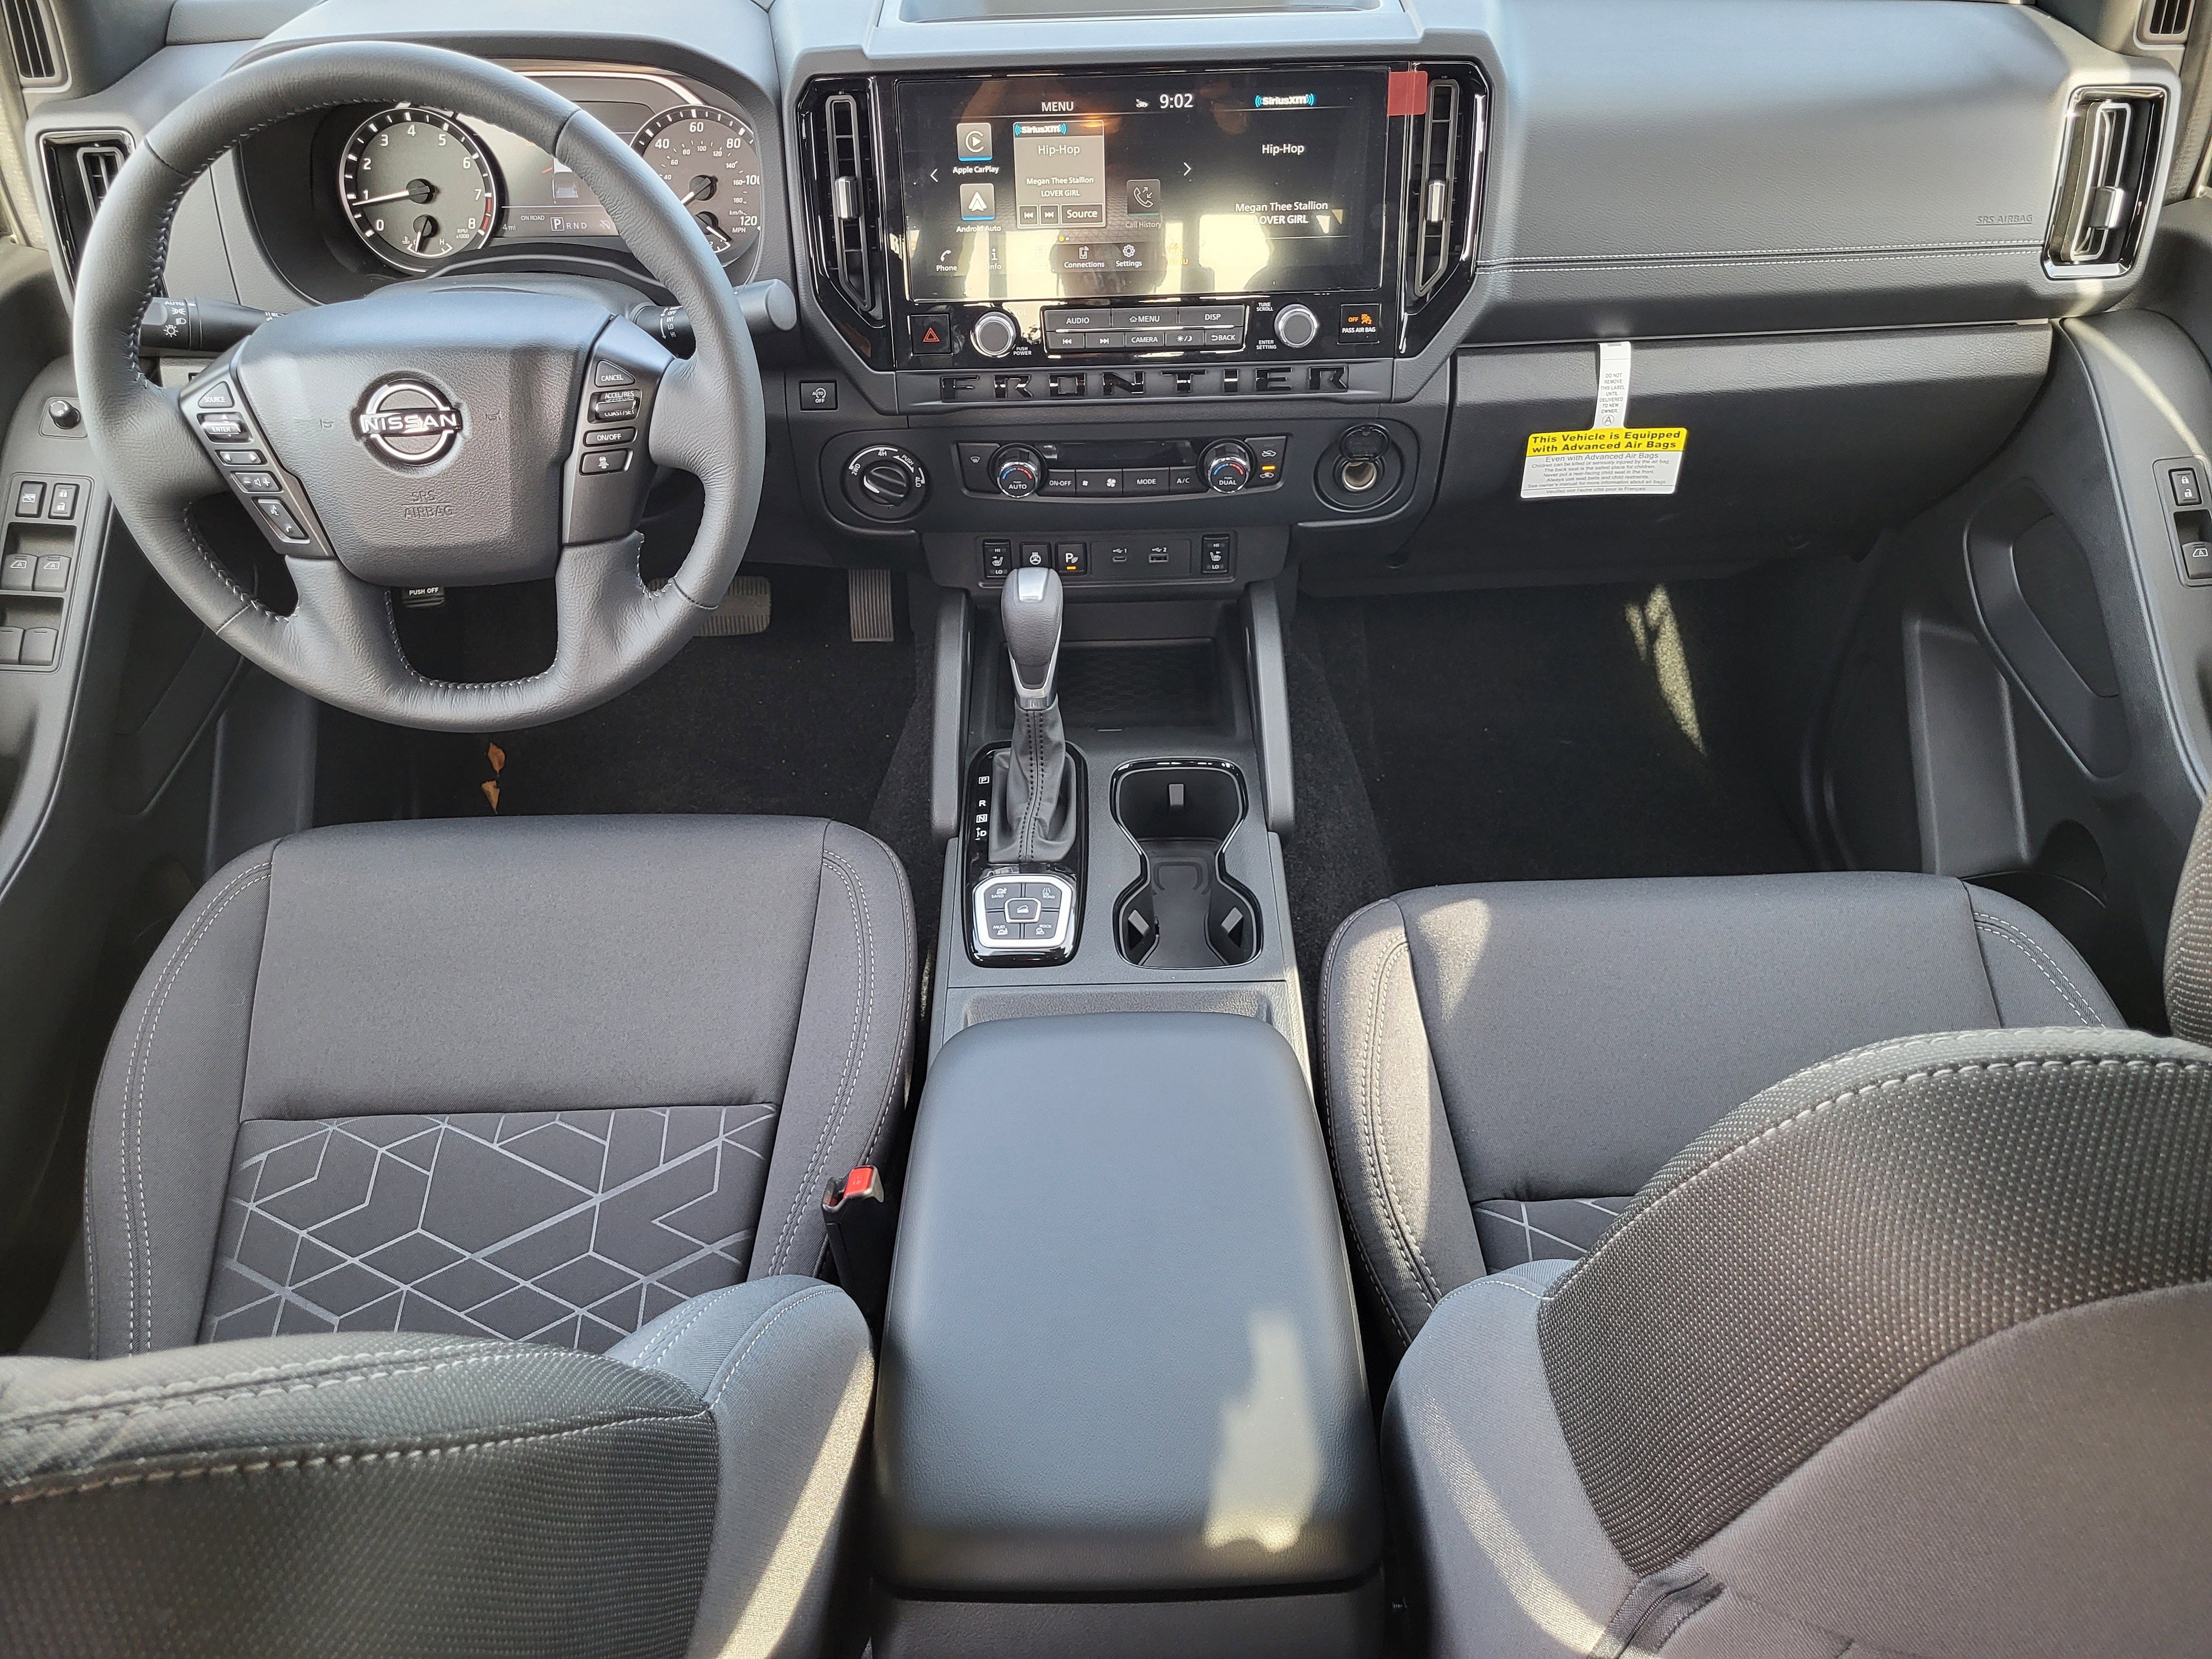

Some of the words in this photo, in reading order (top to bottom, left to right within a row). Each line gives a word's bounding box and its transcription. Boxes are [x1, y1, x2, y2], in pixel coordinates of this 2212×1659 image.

[1041, 101, 1074, 112] MENU
[1159, 93, 1193, 109] 9:02
[407, 124, 416, 136] 4
[689, 122, 704, 132] 60
[381, 134, 389, 147] 3
[439, 134, 446, 146] 5
[655, 138, 670, 149] 40
[726, 138, 741, 149] 80
[1038, 145, 1080, 156] Hip-Hop
[1262, 144, 1305, 156] Hip-Hop
[363, 158, 371, 170] 2
[463, 157, 471, 169] 6
[953, 166, 973, 175] Apple
[1026, 178, 1050, 186] Megan
[363, 190, 369, 200] 1
[474, 189, 482, 200] 7
[1235, 203, 1267, 213] Megan
[1269, 202, 1292, 211] Thee
[1293, 200, 1328, 211] Stallion
[1067, 210, 1098, 218] Source
[1998, 215, 2032, 223] AIRBAG
[376, 220, 384, 231] 0
[468, 218, 476, 229] 8
[554, 218, 561, 229] P
[740, 216, 757, 226] 120
[1139, 221, 1161, 229] History
[1255, 215, 1286, 225] LOVER
[1286, 215, 1308, 224] GIRL
[1138, 315, 1160, 323] MENU
[941, 366, 1348, 400] FRONTIER
[361, 414, 457, 432] NISSAN
[1562, 433, 1605, 442] Vehicle
[1625, 431, 1681, 440] Equipped
[1532, 445, 1558, 453] with
[1562, 442, 1621, 451] Advanced
[1646, 441, 1676, 450] Bags
[901, 454, 914, 466] PUSH
[851, 463, 861, 476] 2WD
[411, 491, 437, 502] SRS
[404, 505, 454, 519] AIRBAG
